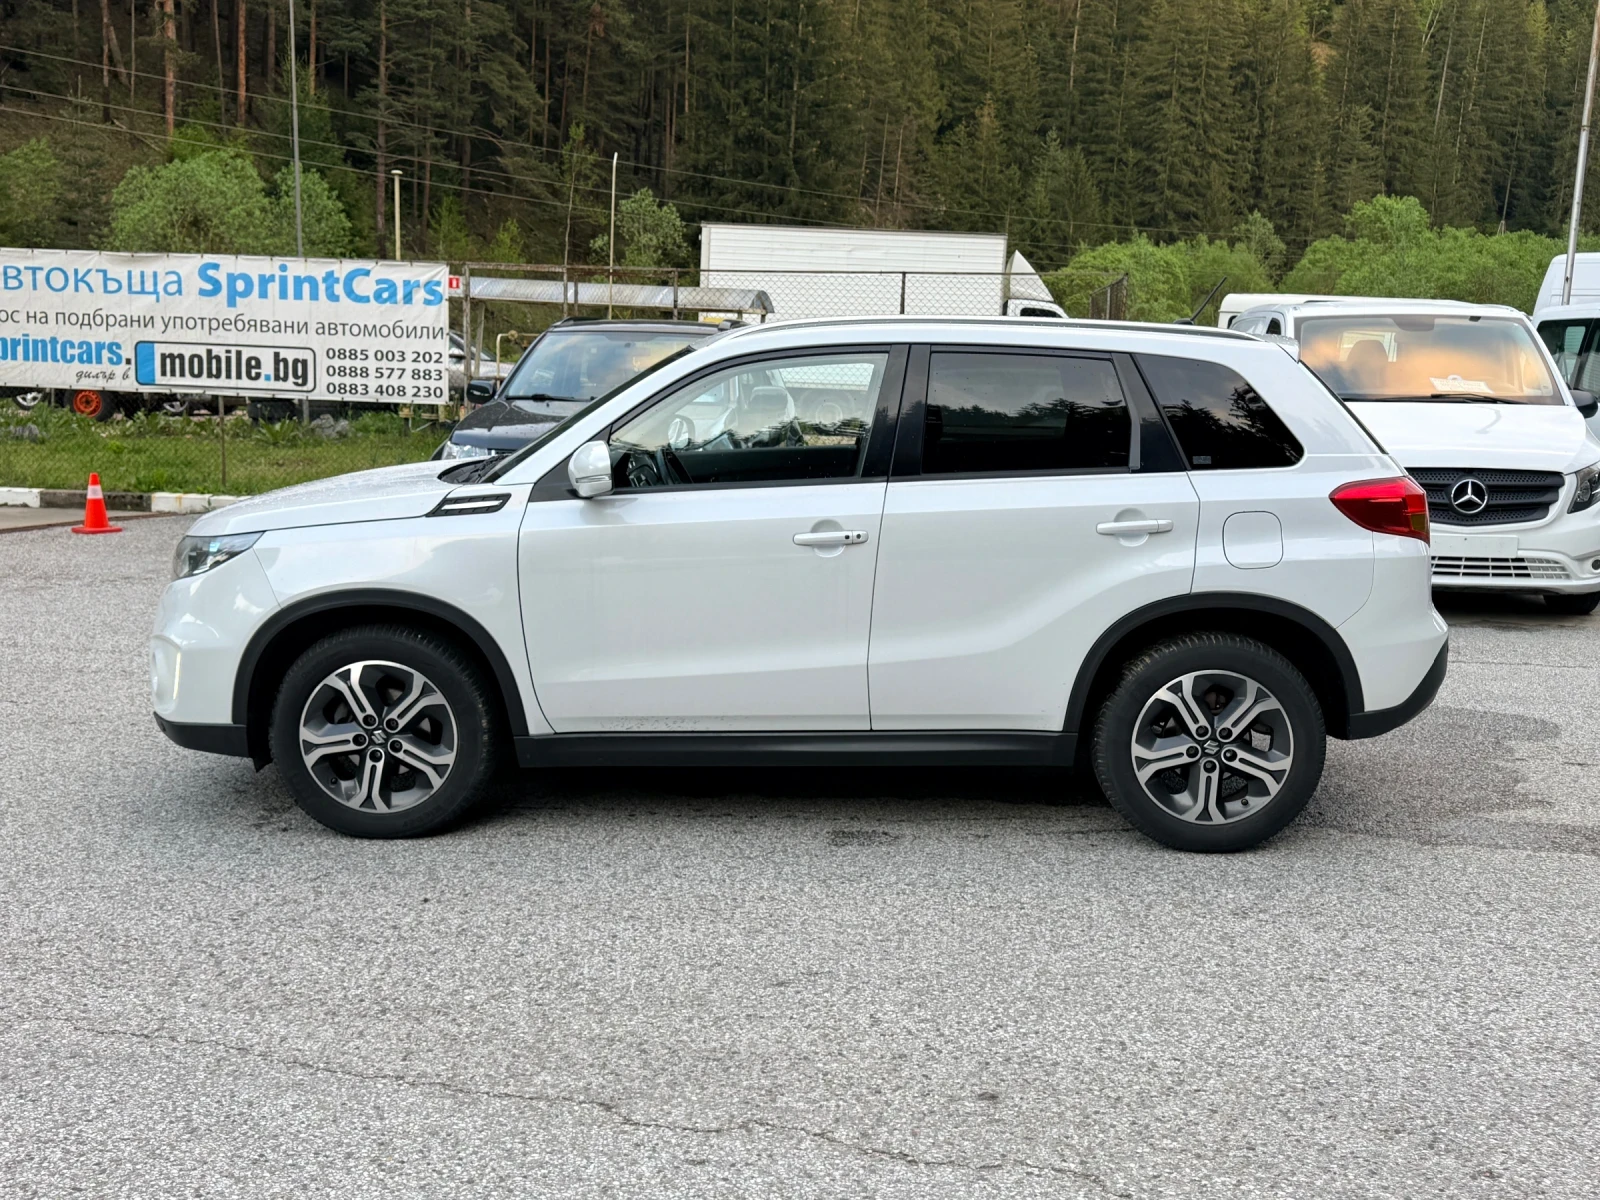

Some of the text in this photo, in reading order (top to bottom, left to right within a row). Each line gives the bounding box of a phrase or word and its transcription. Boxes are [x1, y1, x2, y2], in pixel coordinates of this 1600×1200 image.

[197, 262, 444, 308] SprintCars
[26, 311, 48, 324] на
[55, 308, 155, 332] подбрани
[161, 313, 308, 335] употребявани
[315, 320, 444, 340] автомобили
[326, 347, 443, 363] 0885 003 202
[160, 348, 308, 387] mobile.bg
[326, 365, 443, 381] 0888 577 883
[326, 383, 443, 398] 0883 408 230
